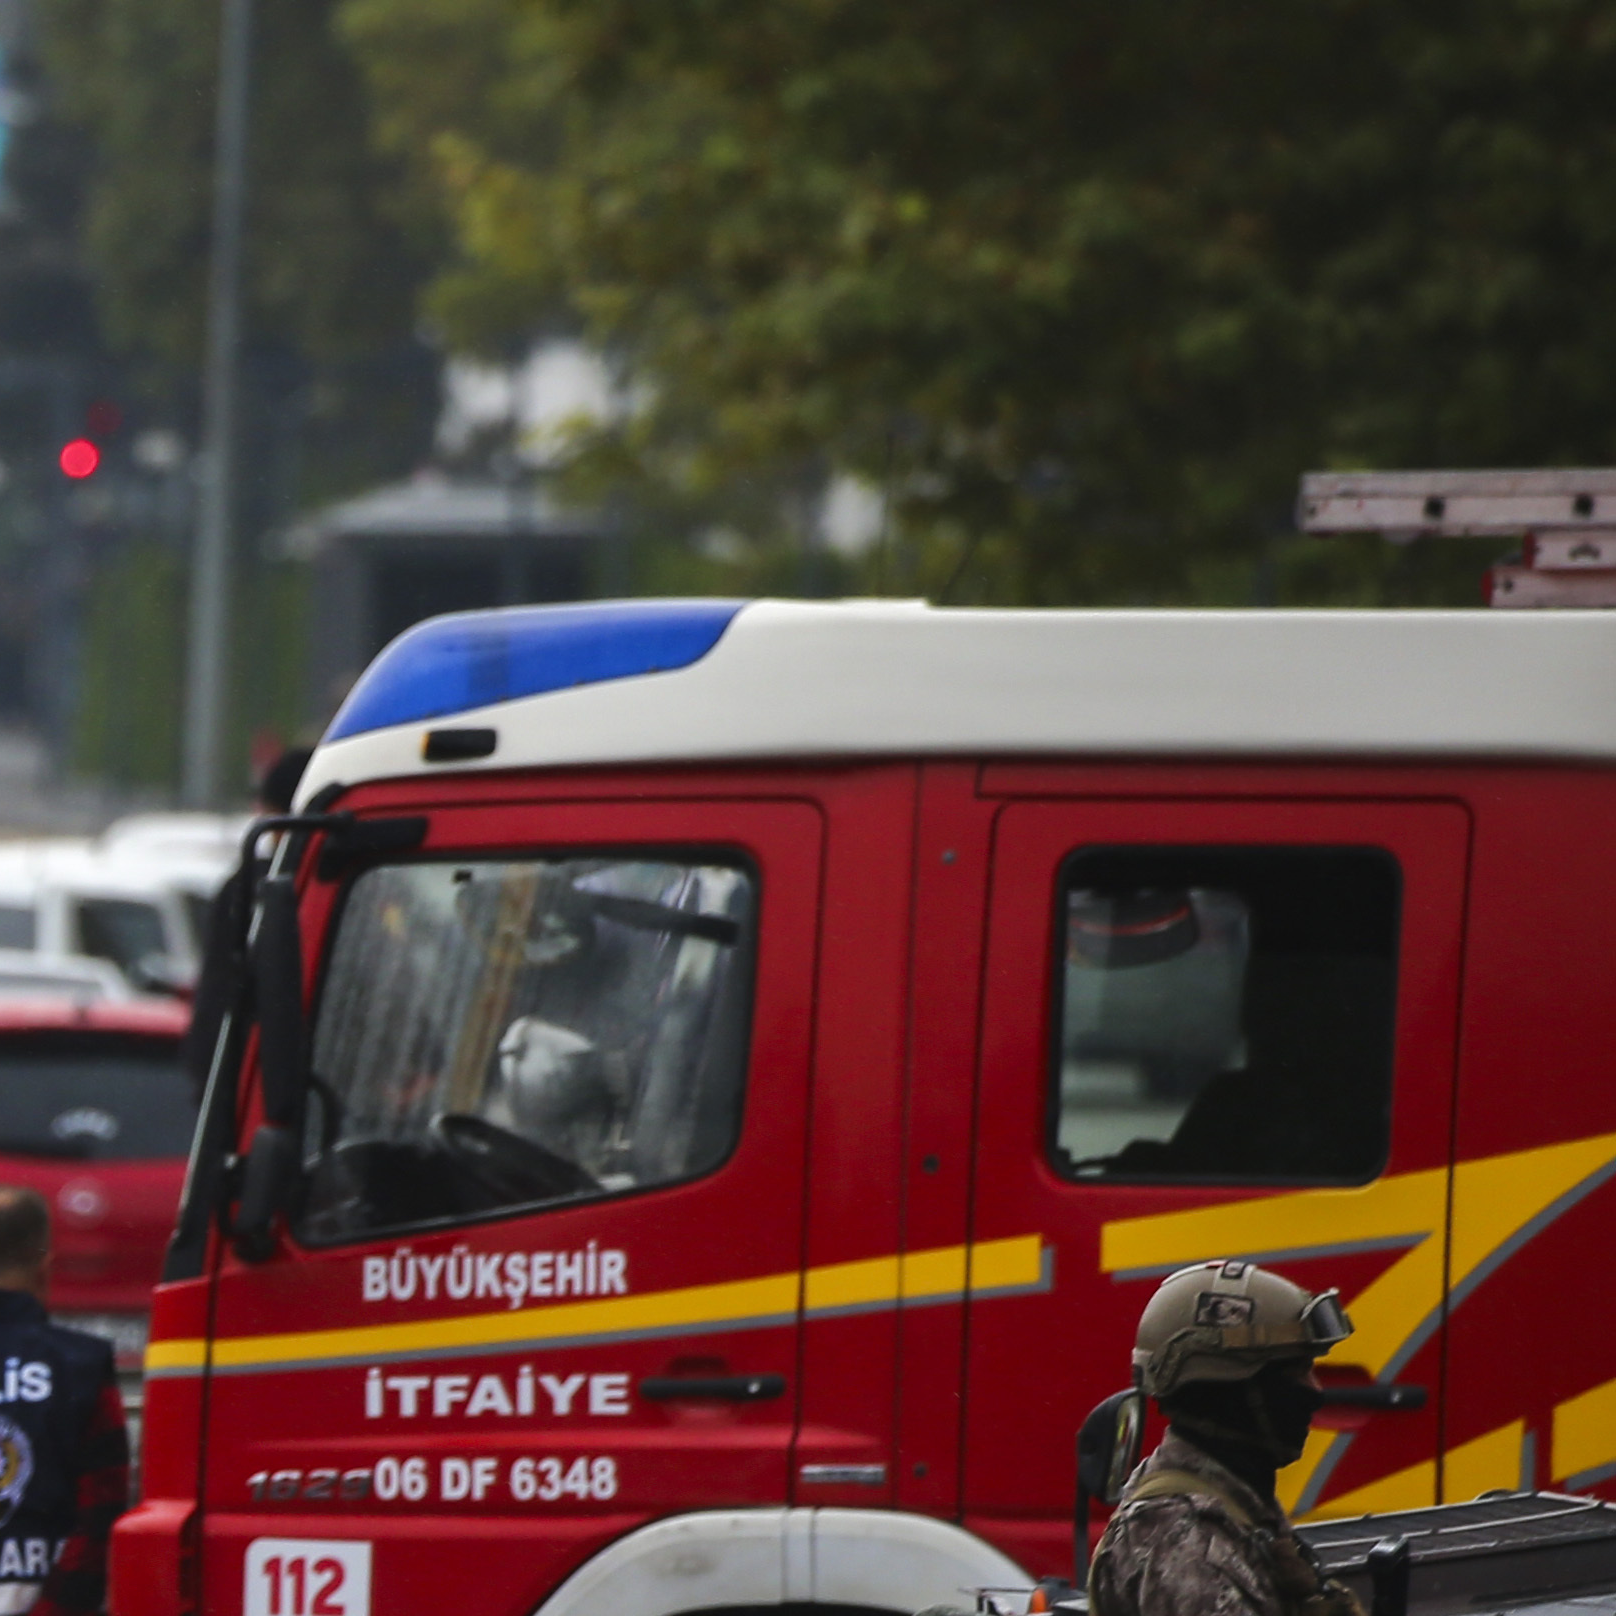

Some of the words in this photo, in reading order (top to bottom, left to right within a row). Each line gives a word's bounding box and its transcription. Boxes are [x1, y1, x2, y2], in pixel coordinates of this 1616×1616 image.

[362, 1239, 628, 1310] BÜYÜKŞEHİR
[364, 1366, 631, 1419] İTFAİYE
[373, 1456, 429, 1501] 06
[440, 1456, 499, 1501] DF
[510, 1455, 618, 1501] 6348
